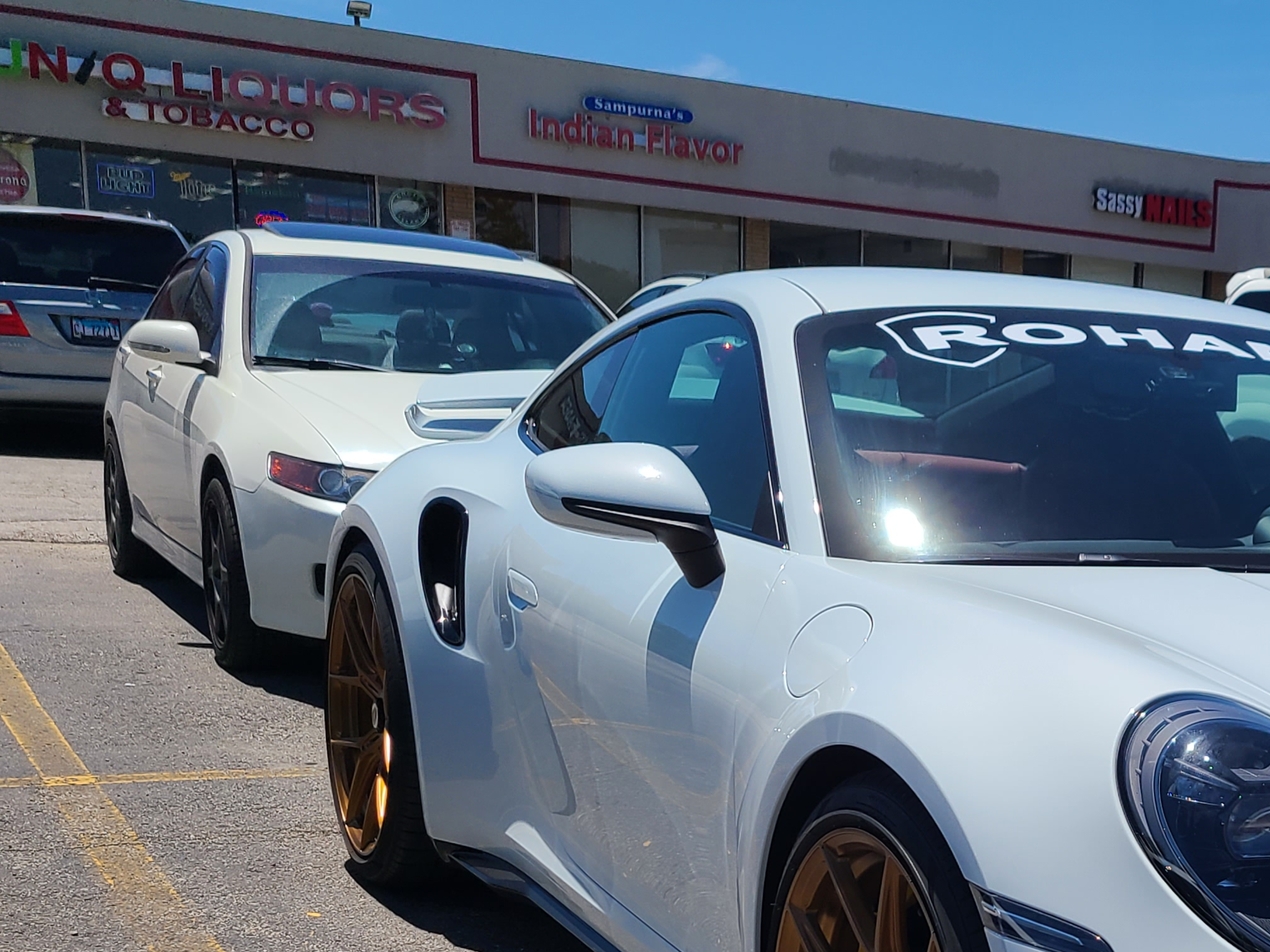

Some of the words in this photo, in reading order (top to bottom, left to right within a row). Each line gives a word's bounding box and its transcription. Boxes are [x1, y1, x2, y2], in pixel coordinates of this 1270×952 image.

[170, 59, 447, 130] LIQUORS
[594, 98, 684, 121] Sampurna's
[105, 96, 130, 118] &
[144, 100, 316, 141] TOBACCO
[528, 108, 635, 151] Indian
[645, 124, 744, 165] Flavor
[100, 177, 152, 195] LIGHT
[106, 166, 144, 181] BUD
[1096, 187, 1143, 219] Sassy
[1145, 193, 1212, 228] NAILS
